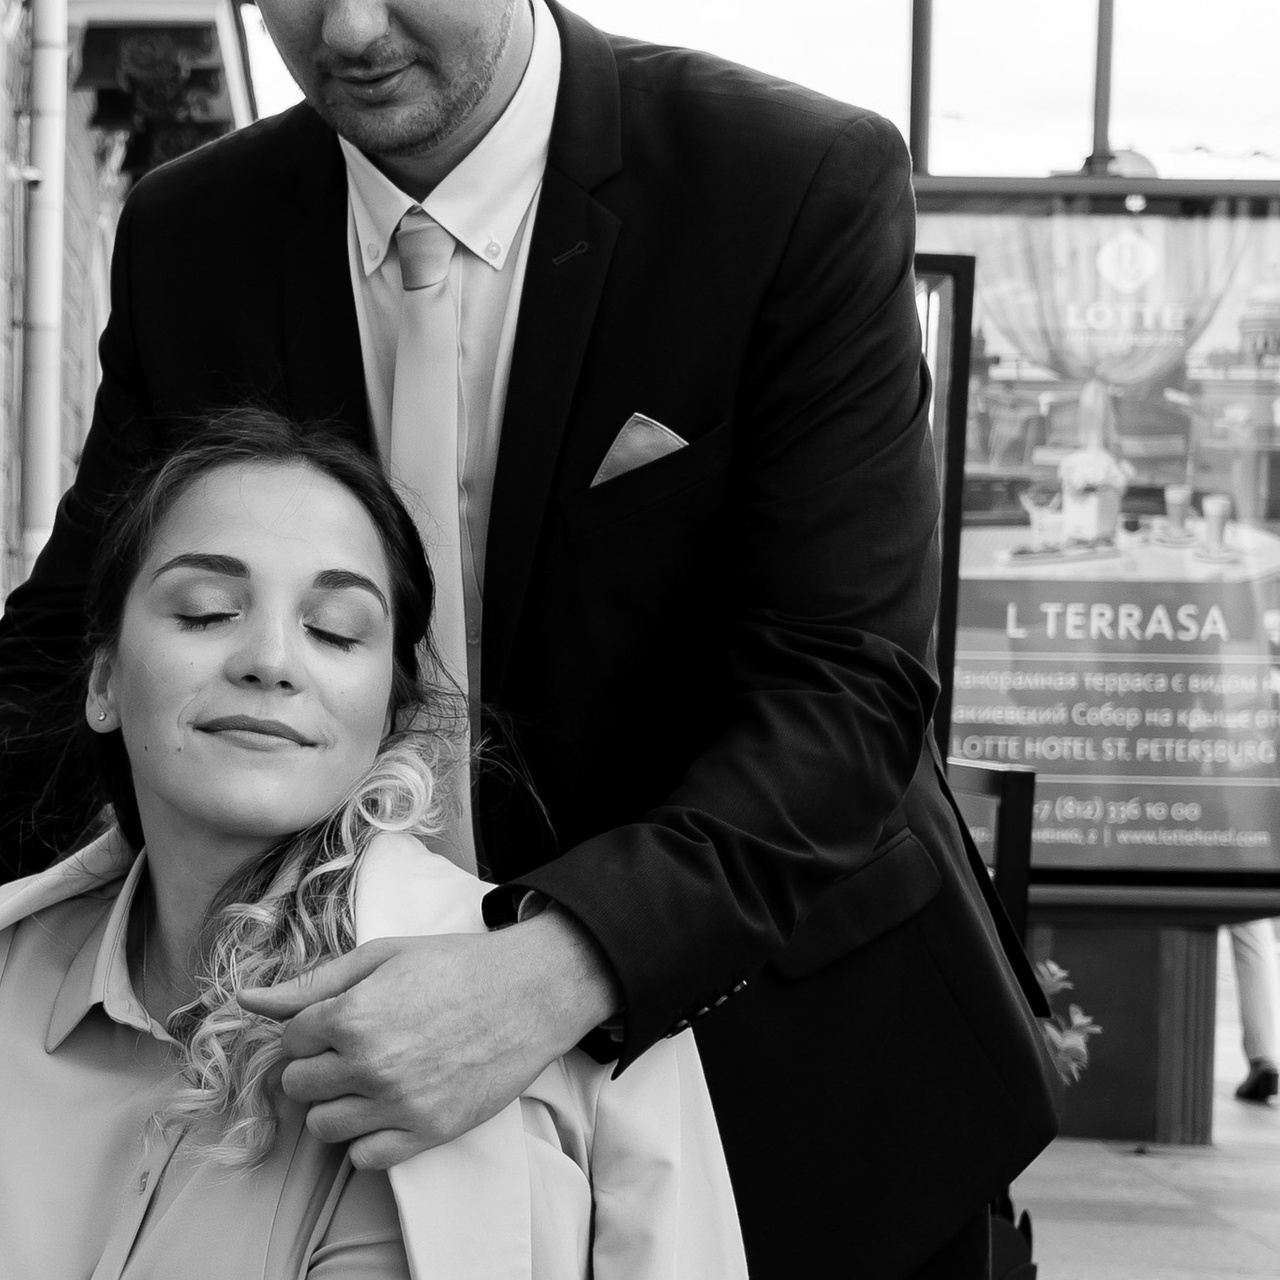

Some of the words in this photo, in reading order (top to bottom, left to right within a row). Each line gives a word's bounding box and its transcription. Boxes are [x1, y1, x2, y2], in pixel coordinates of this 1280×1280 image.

[1067, 300, 1185, 332] LOTTE
[1006, 602, 1028, 639] L
[1039, 602, 1230, 642] TERRASA
[1083, 672, 1169, 697] терраса
[952, 702, 1069, 726] акиевский
[1071, 701, 1143, 731] Собор
[1145, 707, 1174, 727] на
[952, 735, 1021, 759] LOTTE
[1024, 735, 1100, 761] HOTEL
[1101, 737, 1133, 761] ST.
[1136, 738, 1277, 763] PETERSBURG
[1055, 796, 1105, 823] (812)
[1145, 802, 1169, 821] 10
[1170, 802, 1202, 822] 00
